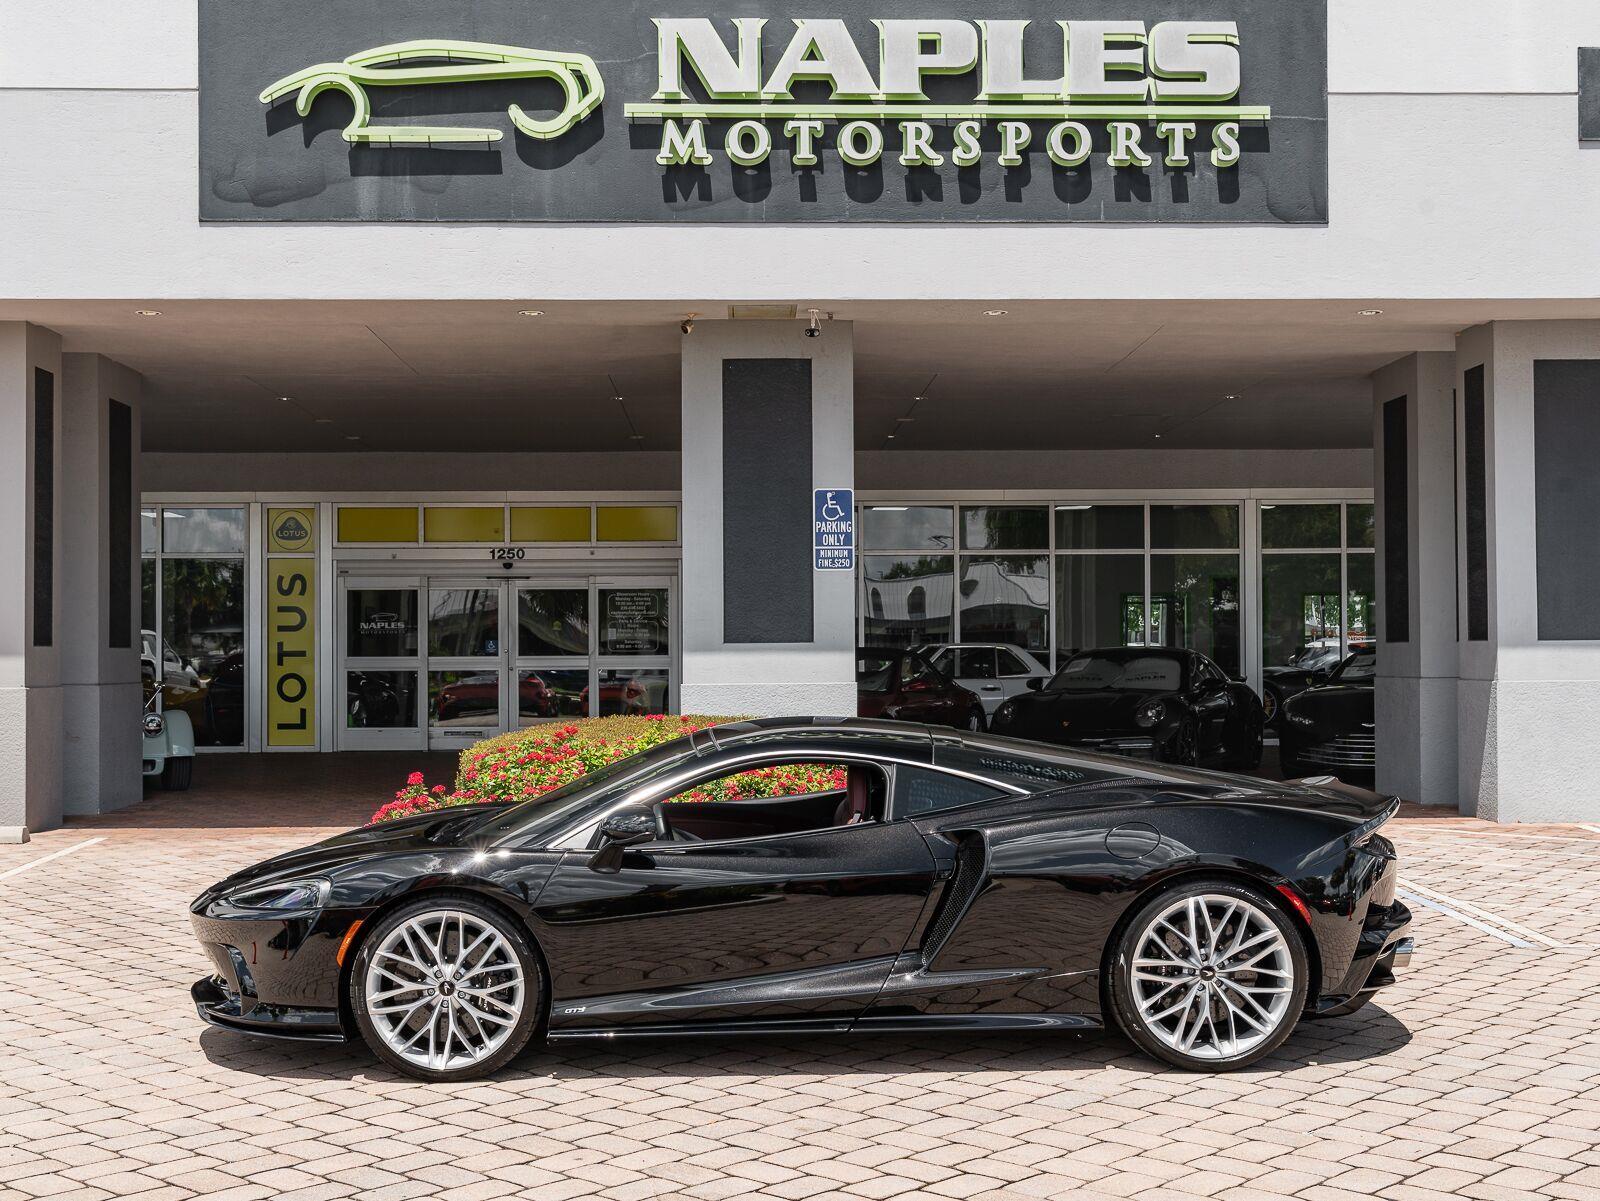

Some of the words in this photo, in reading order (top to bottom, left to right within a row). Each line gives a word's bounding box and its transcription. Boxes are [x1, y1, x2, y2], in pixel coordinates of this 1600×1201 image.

[651, 18, 1241, 102] NAPLES
[656, 119, 1241, 167] MOTORSPORTS
[815, 521, 852, 533] PARKING
[822, 534, 845, 546] ONLY
[489, 548, 526, 560] 1250
[820, 549, 849, 558] MINIMUM
[818, 558, 833, 568] FINE
[835, 558, 850, 568] $250
[277, 573, 307, 731] LOTUS
